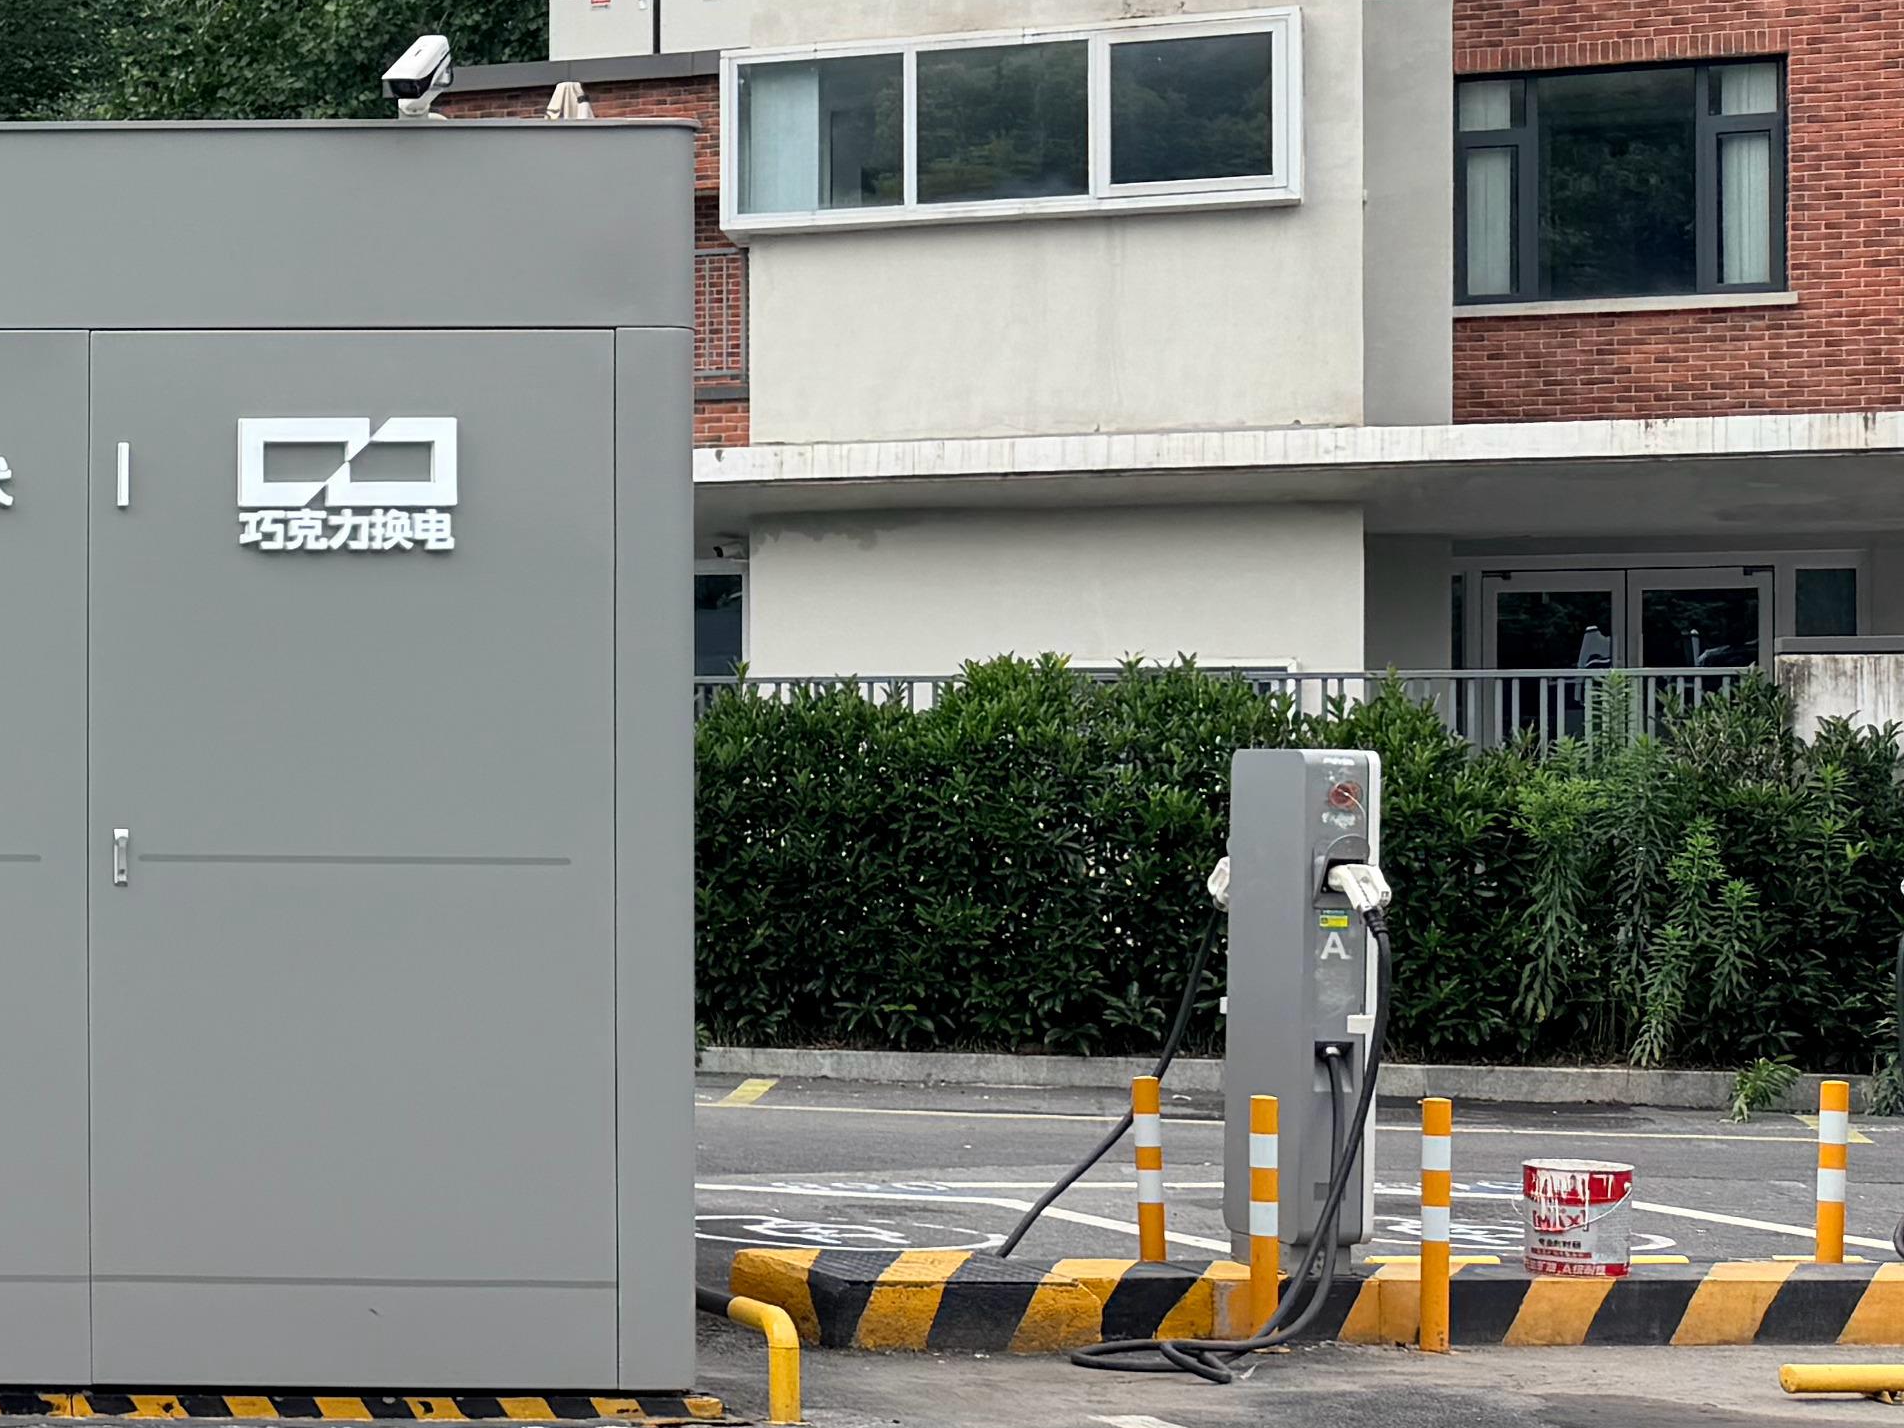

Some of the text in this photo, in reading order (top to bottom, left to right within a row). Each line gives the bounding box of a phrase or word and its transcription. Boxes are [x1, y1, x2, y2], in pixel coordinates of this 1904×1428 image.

[239, 508, 456, 551] 巧克力换电
[1320, 931, 1348, 960] A
